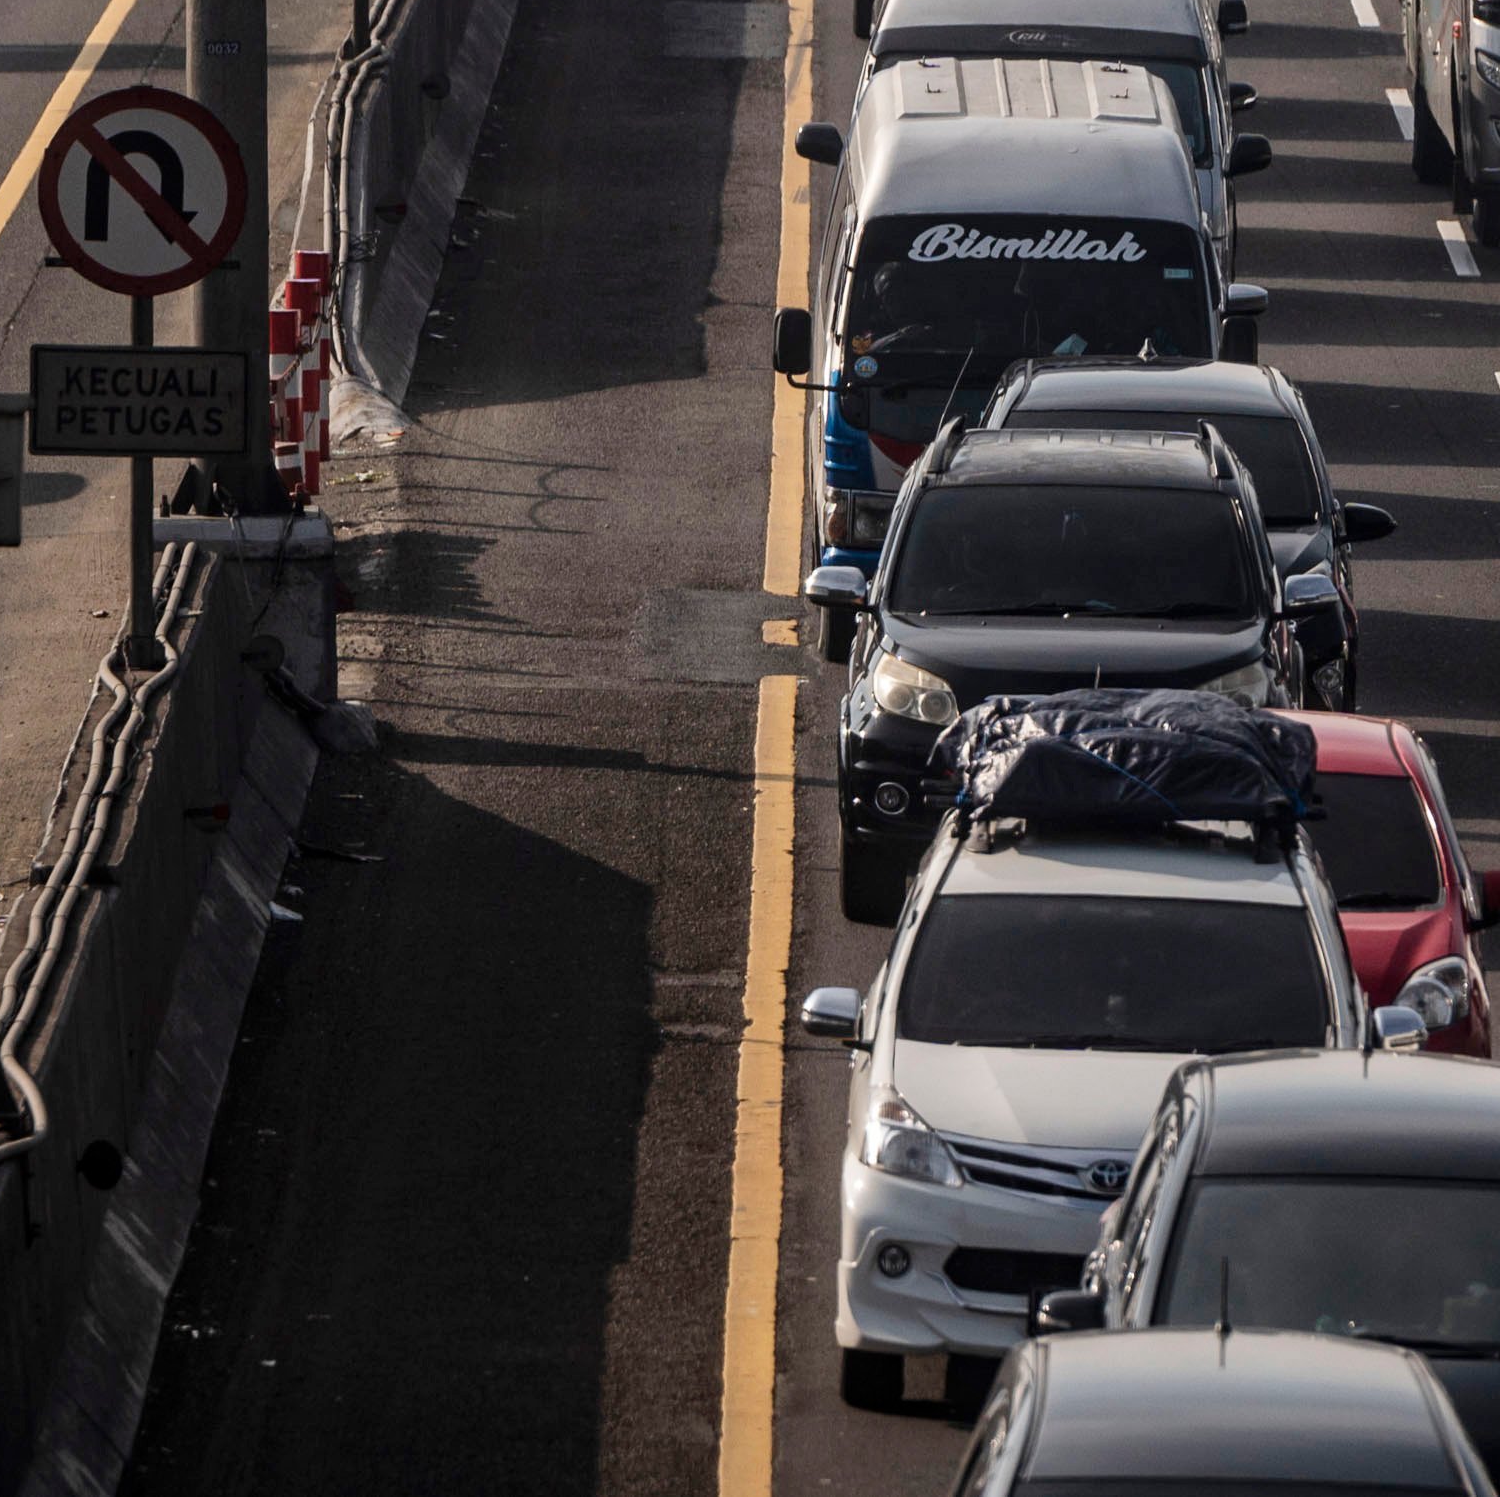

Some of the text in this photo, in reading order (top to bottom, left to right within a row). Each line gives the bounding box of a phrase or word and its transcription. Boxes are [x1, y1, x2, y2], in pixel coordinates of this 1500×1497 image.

[908, 223, 1147, 262] Bismillah
[64, 366, 218, 398] KECUALI
[55, 405, 224, 437] PETUGAS
